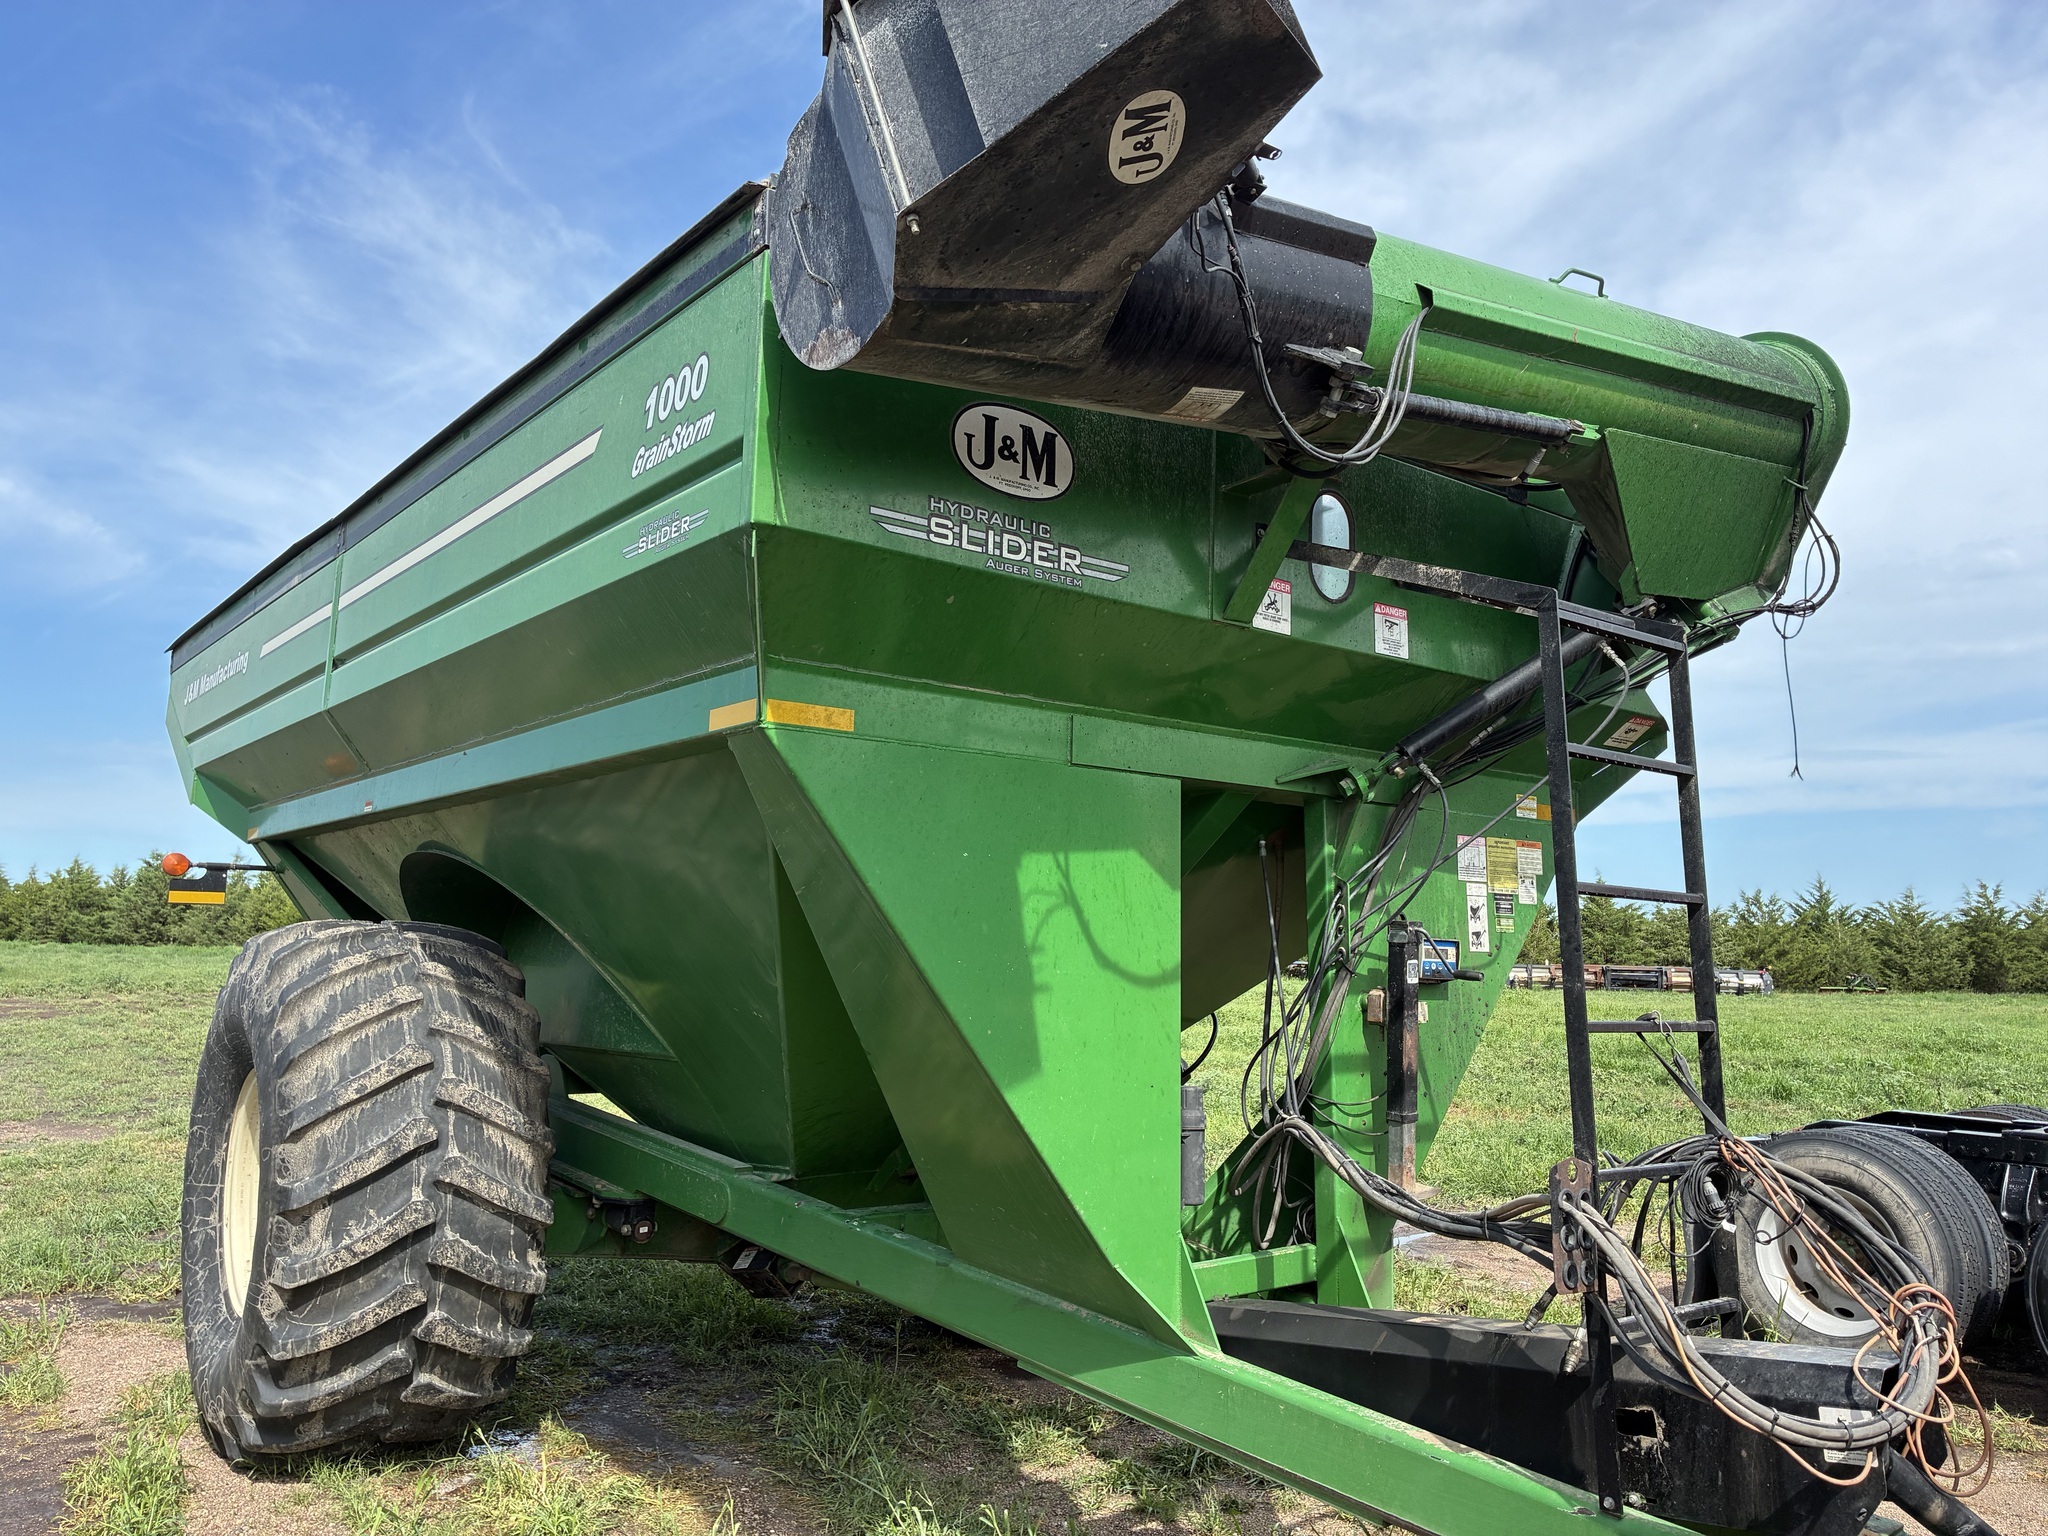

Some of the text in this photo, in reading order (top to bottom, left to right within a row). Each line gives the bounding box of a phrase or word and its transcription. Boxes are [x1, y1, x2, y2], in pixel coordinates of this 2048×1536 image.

[1118, 99, 1171, 178] J&M
[645, 352, 710, 432] 1000
[631, 409, 716, 480] GrainStorm
[963, 413, 1059, 488] J&M
[637, 515, 691, 553] SLIDER
[640, 511, 680, 535] HYDRAULIC
[929, 496, 1052, 538] HYDRAULIC
[927, 516, 1084, 576] SLIDER
[986, 558, 1083, 588] AUGER SYSTEM
[1269, 579, 1291, 594] NGER
[1381, 606, 1408, 618] DANGER
[199, 651, 250, 696] Manufacturing
